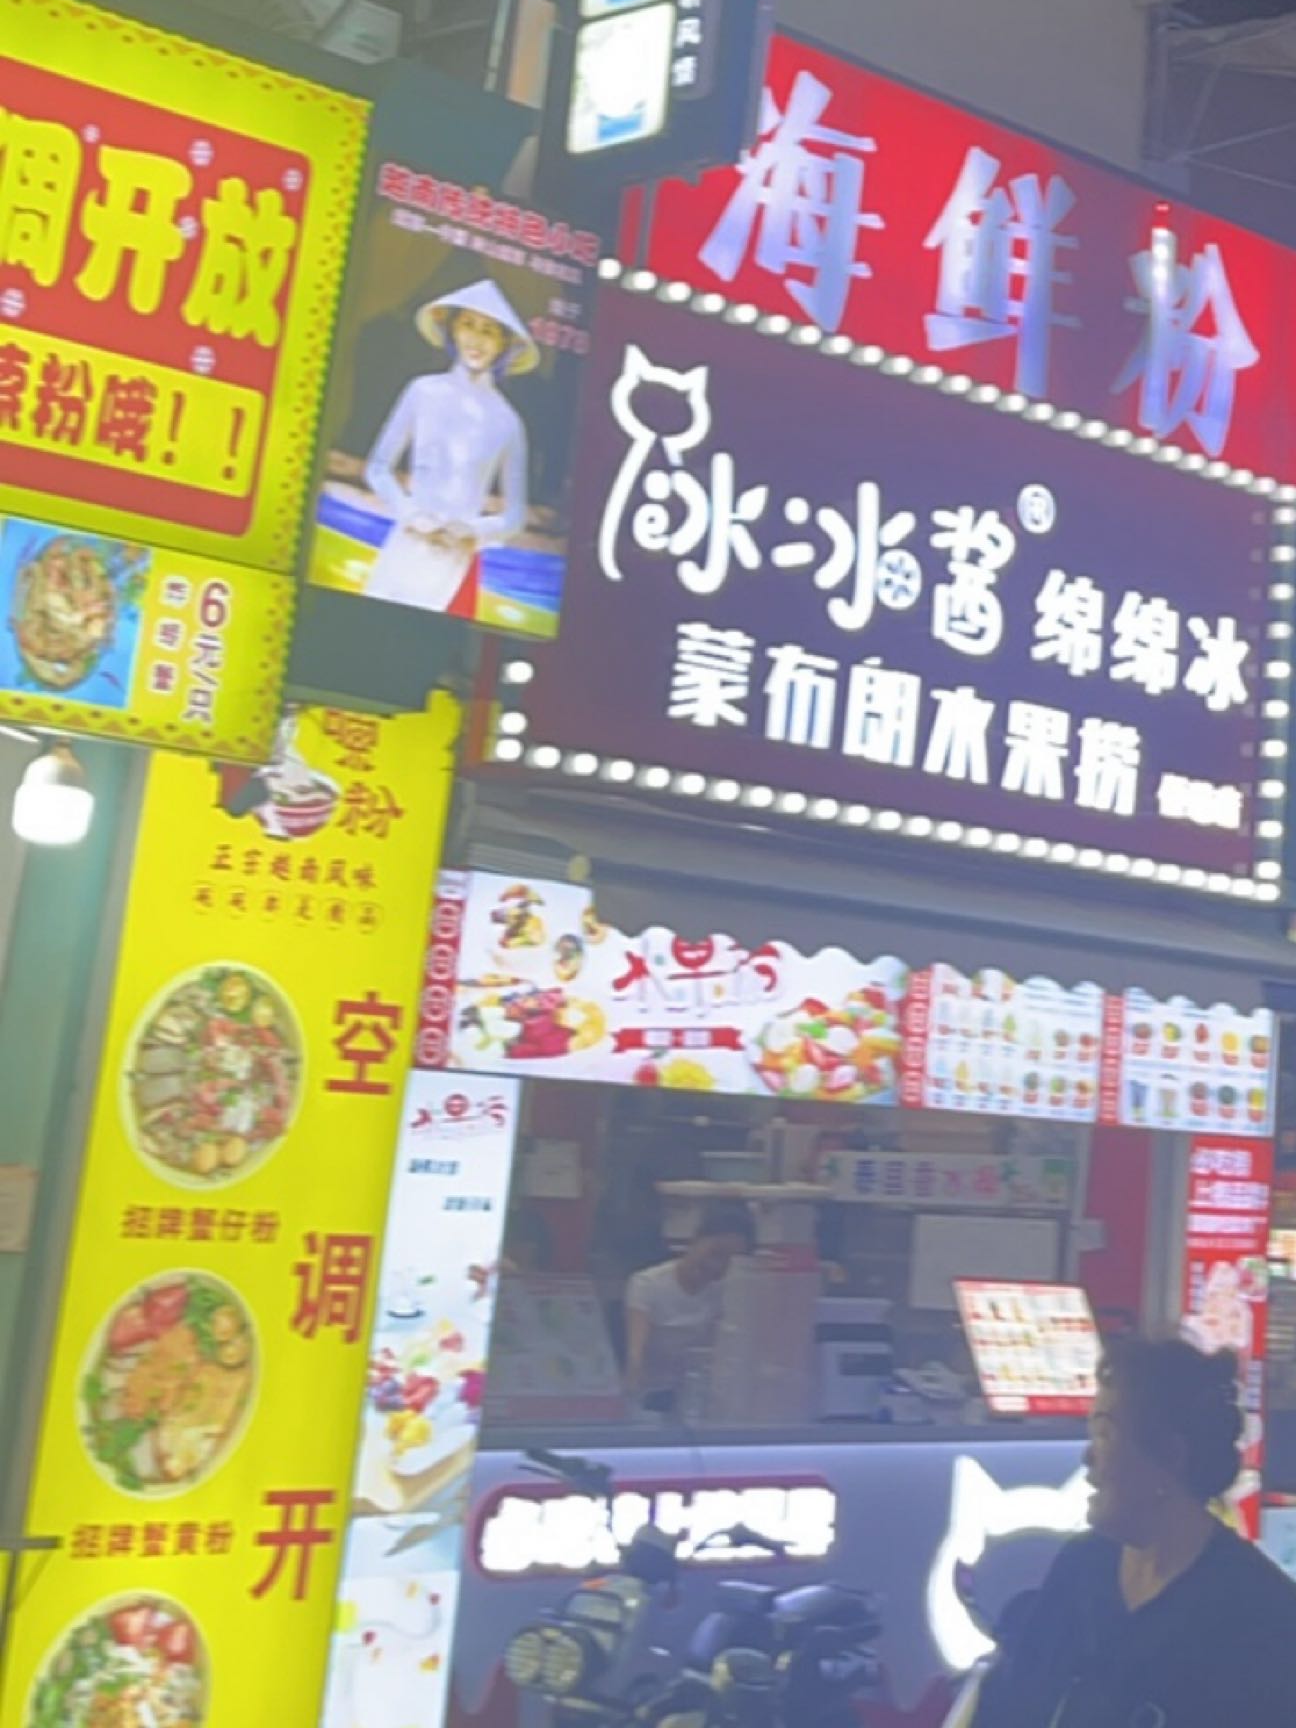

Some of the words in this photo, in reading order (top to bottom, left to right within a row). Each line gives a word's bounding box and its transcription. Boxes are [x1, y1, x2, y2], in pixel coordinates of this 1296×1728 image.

[182, 580, 230, 724] 6元/只
[1032, 570, 1249, 712] 绵绵冰
[210, 844, 376, 892] 正宗越南风味
[120, 1205, 281, 1244] 招牌蟹仔粉
[70, 1520, 235, 1559] 招牌蟹黄粉
